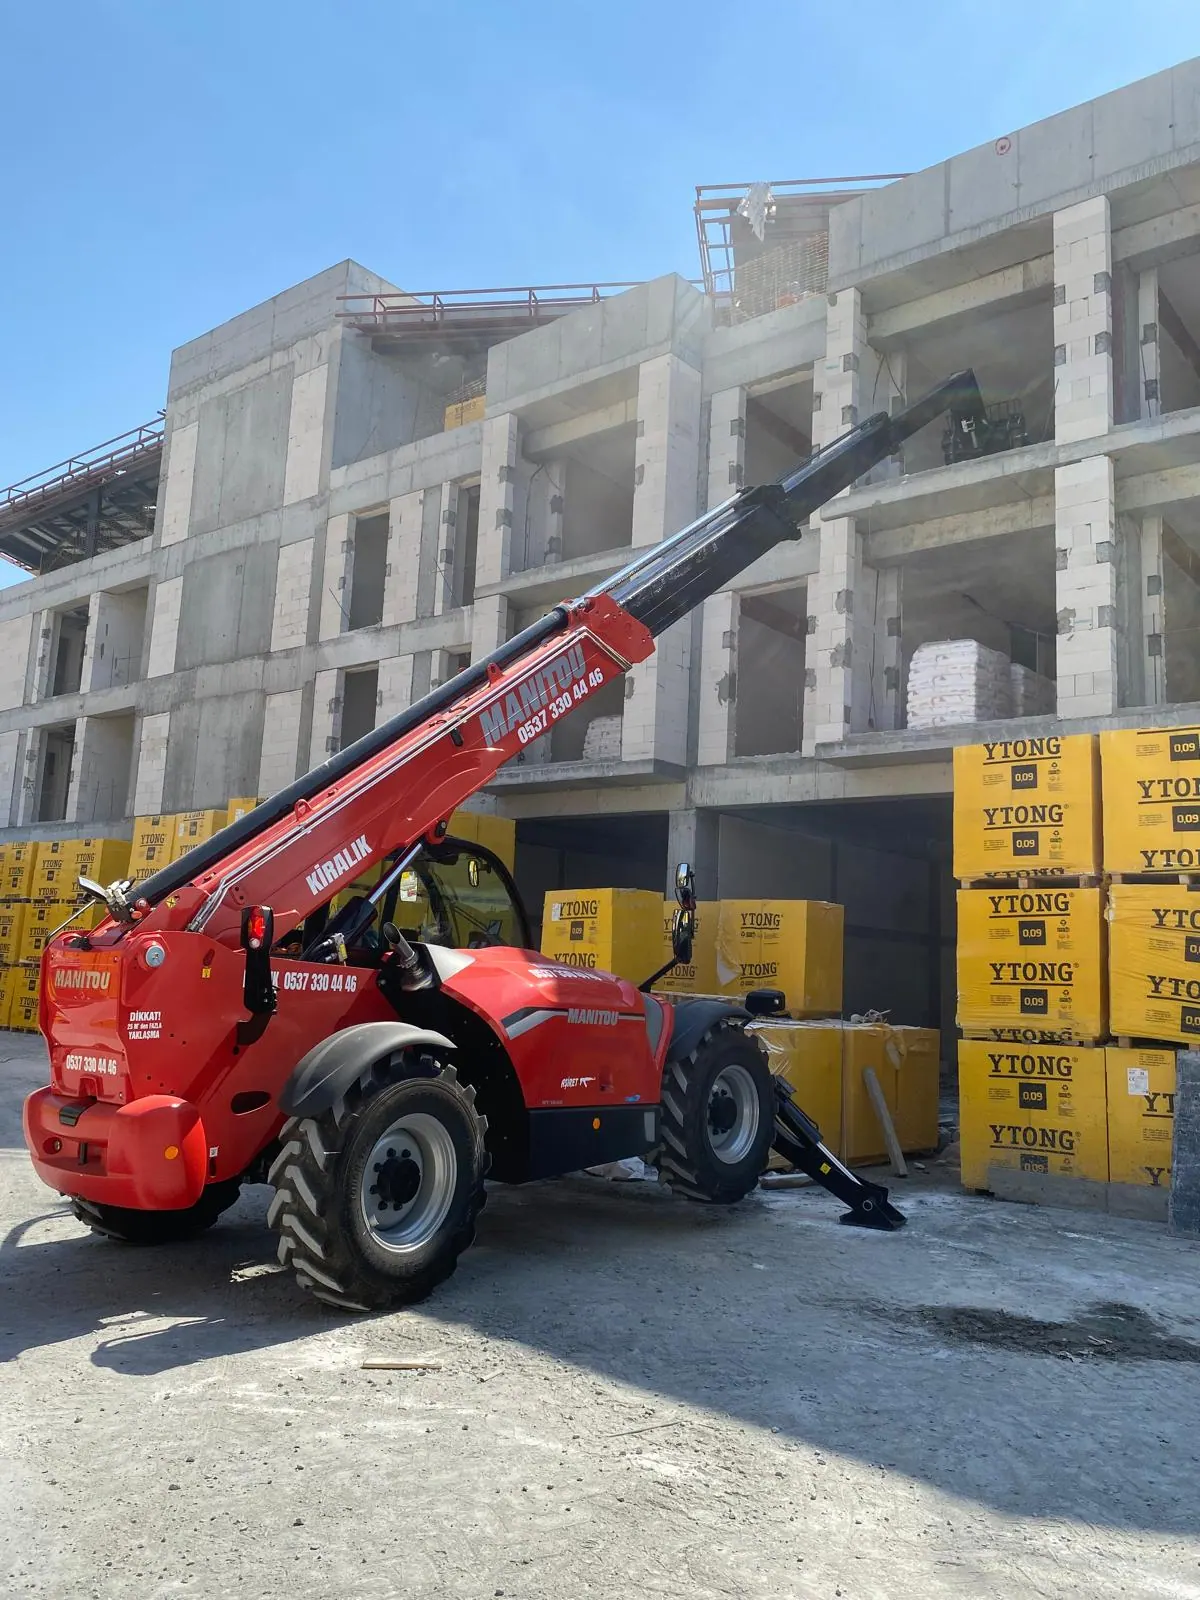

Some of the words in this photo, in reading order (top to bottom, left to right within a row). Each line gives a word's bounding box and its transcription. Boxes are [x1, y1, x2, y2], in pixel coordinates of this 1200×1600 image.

[479, 643, 586, 748] MANITOU
[517, 710, 548, 744] 0537
[549, 692, 573, 719] 330
[573, 680, 588, 700] 44
[589, 667, 604, 687] 46
[983, 737, 1061, 760] YTONG
[1173, 743, 1195, 753] 0,09
[1015, 772, 1034, 782] 0,09
[983, 805, 1064, 825] YTONG
[1177, 814, 1199, 824] 0,09
[141, 834, 165, 844] YTONG
[1016, 839, 1035, 848] 0,09
[305, 834, 373, 896] KİRALIK
[560, 900, 598, 916] YTONG
[988, 893, 1070, 913] YTONG
[741, 913, 780, 926] YTONG
[1022, 929, 1042, 938] 0,09
[740, 962, 777, 976] YTONG
[989, 963, 1074, 981] YTONG
[54, 969, 111, 990] MANITOU
[283, 971, 310, 991] 0537
[310, 973, 329, 991] 330
[330, 974, 342, 992] 44
[344, 975, 357, 992] 46
[1024, 997, 1044, 1006] 0,09
[130, 1010, 161, 1021] DİKKAT!
[567, 1008, 619, 1026] MANITOU
[128, 1030, 160, 1040] YAKLAŞMA
[66, 1054, 82, 1070] 0537
[83, 1056, 97, 1072] 330
[98, 1058, 107, 1074] 44
[108, 1059, 117, 1075] 46
[988, 1054, 1072, 1076] YTONG
[989, 1125, 1075, 1150] YTONG
